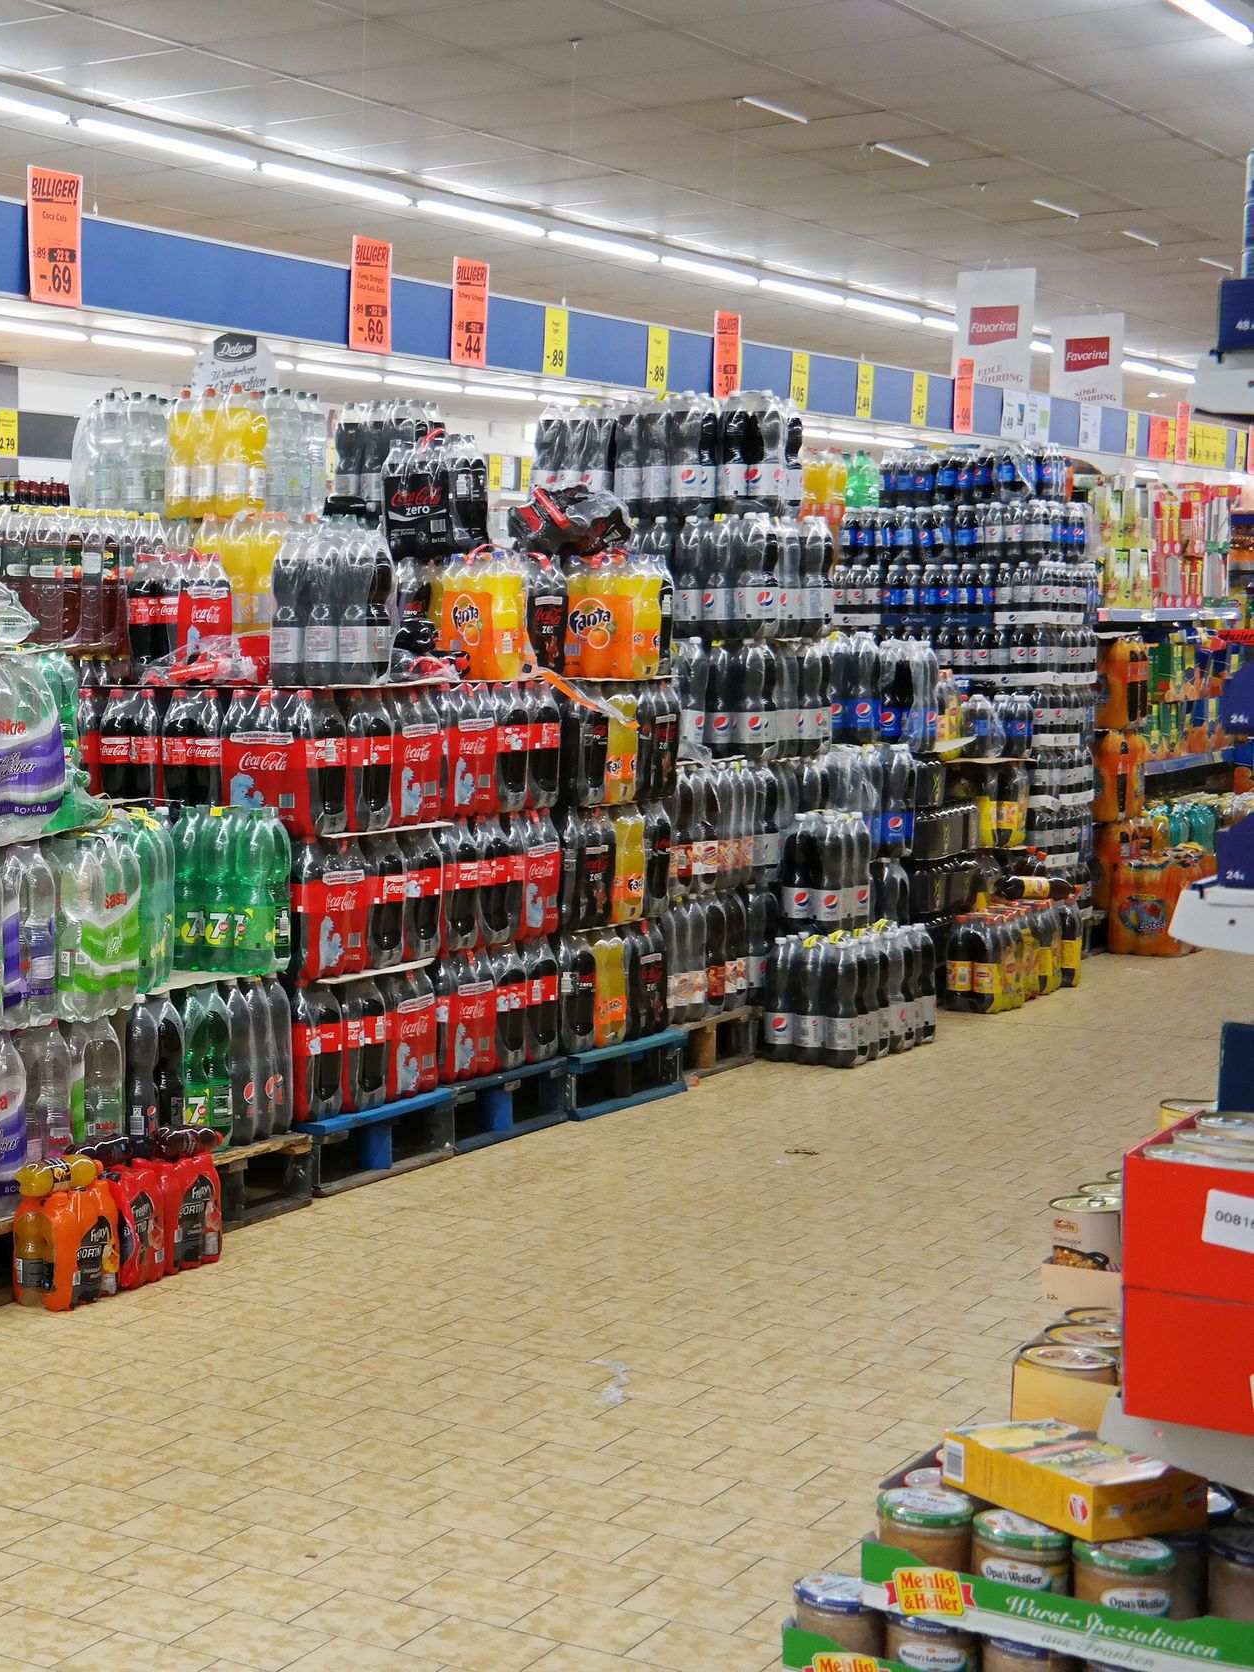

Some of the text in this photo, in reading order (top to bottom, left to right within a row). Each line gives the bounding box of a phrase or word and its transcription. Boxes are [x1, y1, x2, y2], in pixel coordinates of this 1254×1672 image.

[32, 177, 78, 206] BILLIGER!
[42, 211, 67, 223] Coca Cola
[355, 244, 388, 269] BILLIGER!
[40, 264, 72, 295] -.69
[456, 265, 486, 288] BILLIGER!
[357, 318, 384, 344] -.69
[971, 321, 1017, 334] Favorina
[216, 342, 253, 357] Deluxe
[1066, 351, 1108, 362] Favorina
[0, 438, 15, 451] 2.79
[390, 486, 443, 508] Coca-Cola
[405, 504, 430, 517] zero
[451, 606, 480, 631] Fanta
[569, 607, 612, 636] Fanta
[238, 751, 287, 772] Coca-Cola
[899, 1572, 956, 1595] Mehlig
[985, 1564, 1043, 1587] Opa's Weißer
[1109, 1597, 1135, 1610] Opa's
[1041, 1633, 1156, 1669] aus Franken
